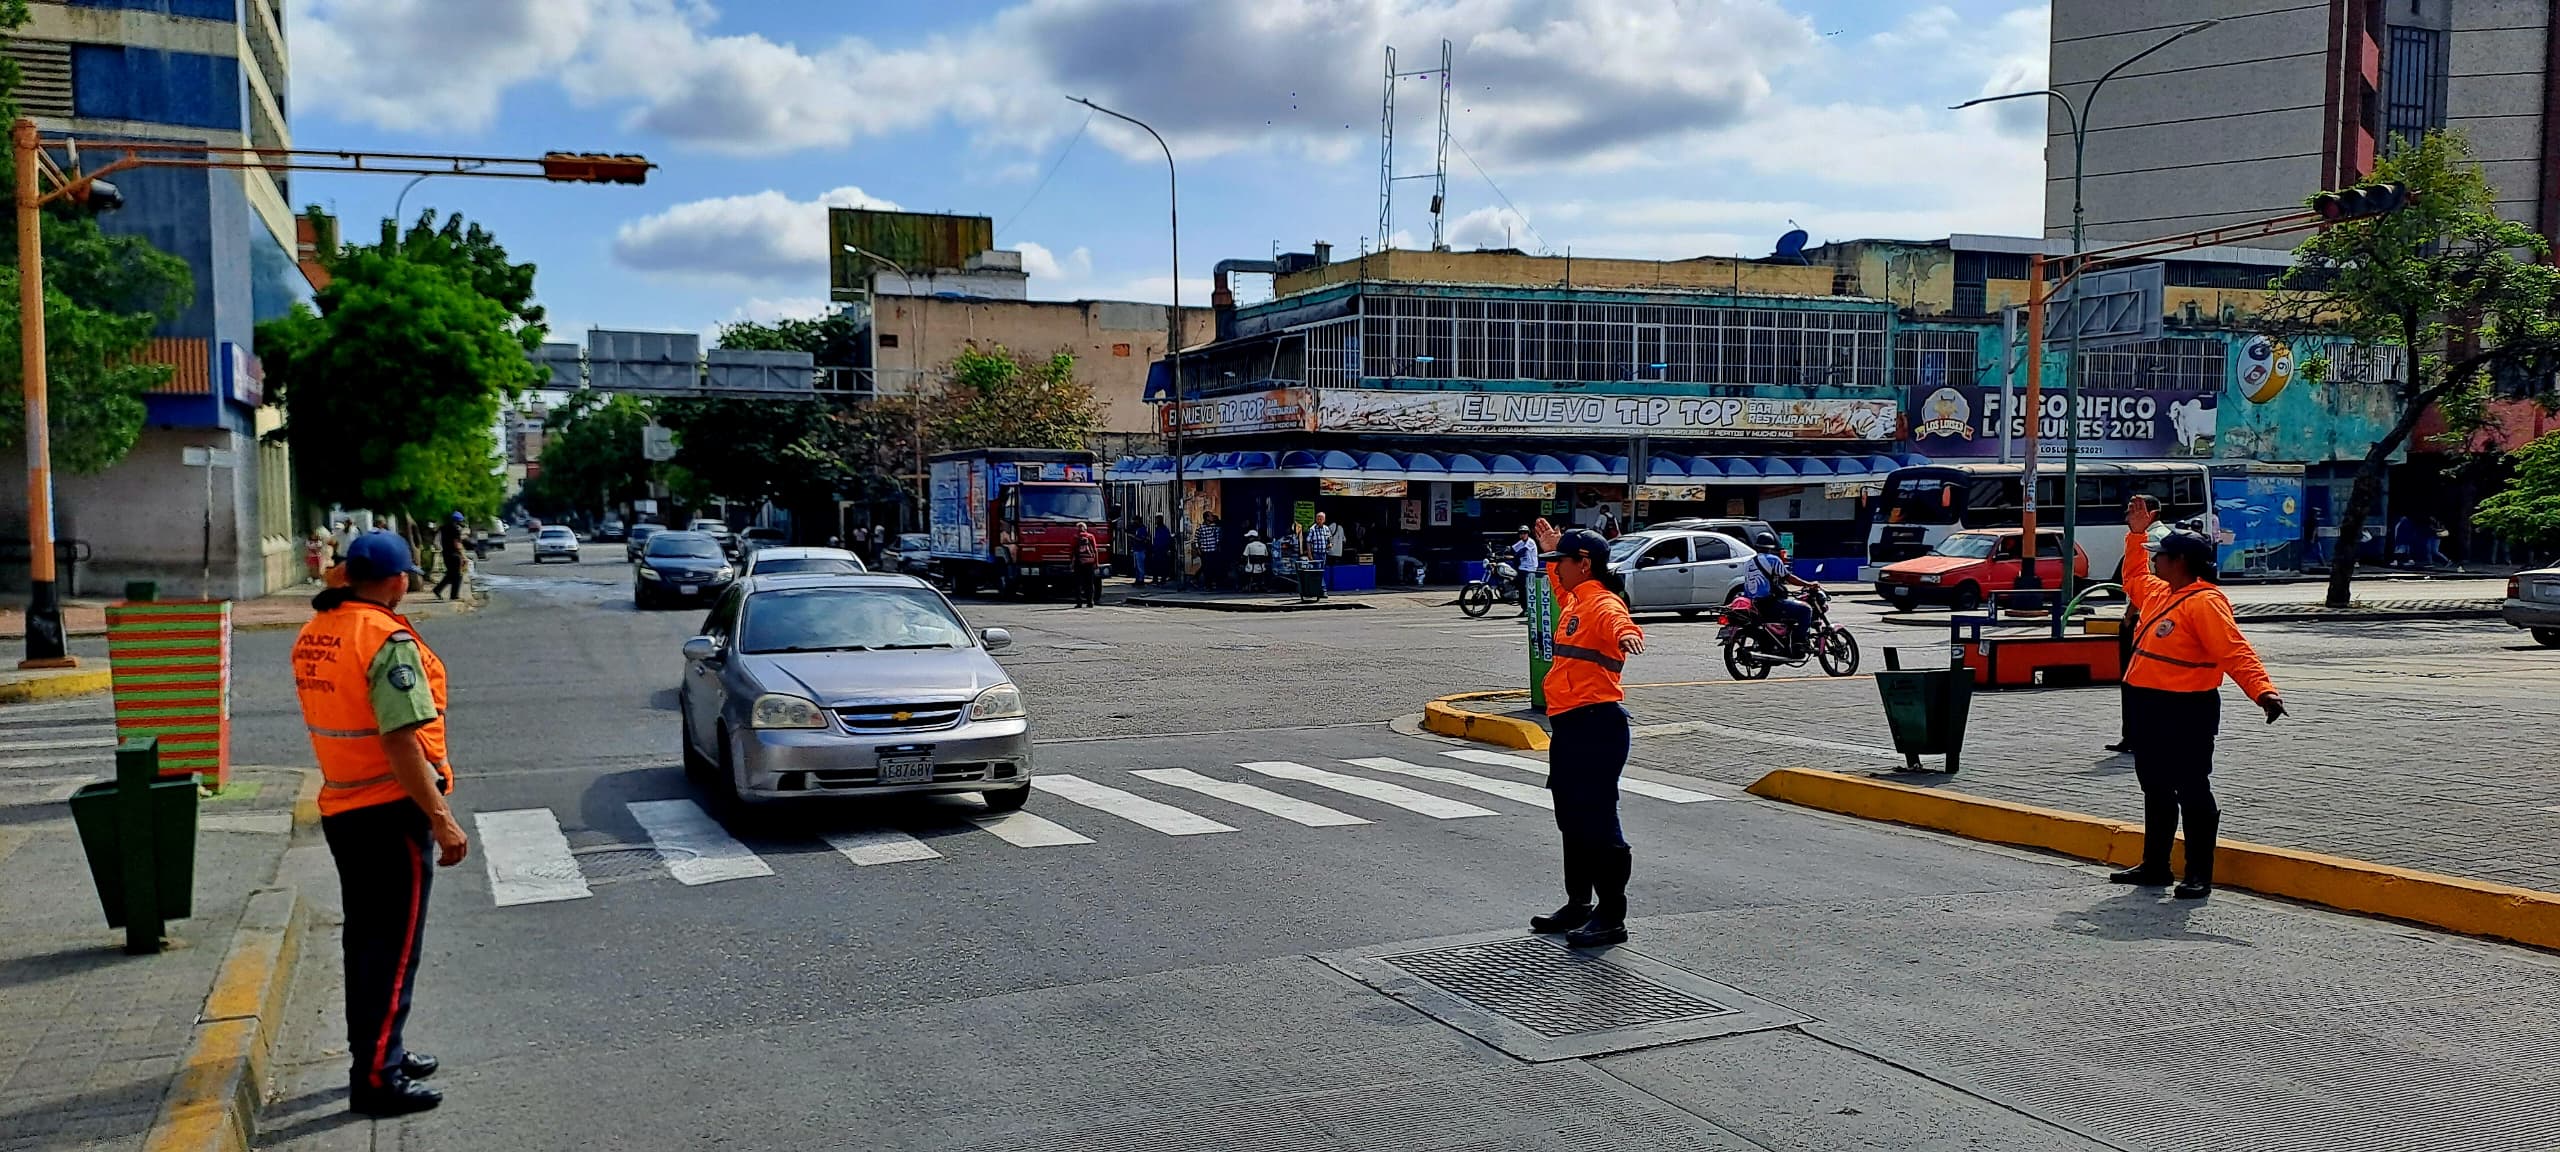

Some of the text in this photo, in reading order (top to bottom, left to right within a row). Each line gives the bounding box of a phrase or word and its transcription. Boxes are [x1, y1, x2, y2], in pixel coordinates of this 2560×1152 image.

[1182, 405, 1213, 424] NUEVO
[1218, 401, 1237, 423] TIP
[1240, 397, 1265, 421] TOP
[1461, 396, 1741, 426] EL NUEVO TIP TOP
[1748, 403, 1772, 414] BAR
[1748, 414, 1821, 425] RESTAURANT
[1926, 420, 1940, 432] LOS
[2037, 418, 2104, 438] UIES
[2110, 420, 2154, 438] 2021
[1541, 590, 1553, 660] VOTA BLANCO
